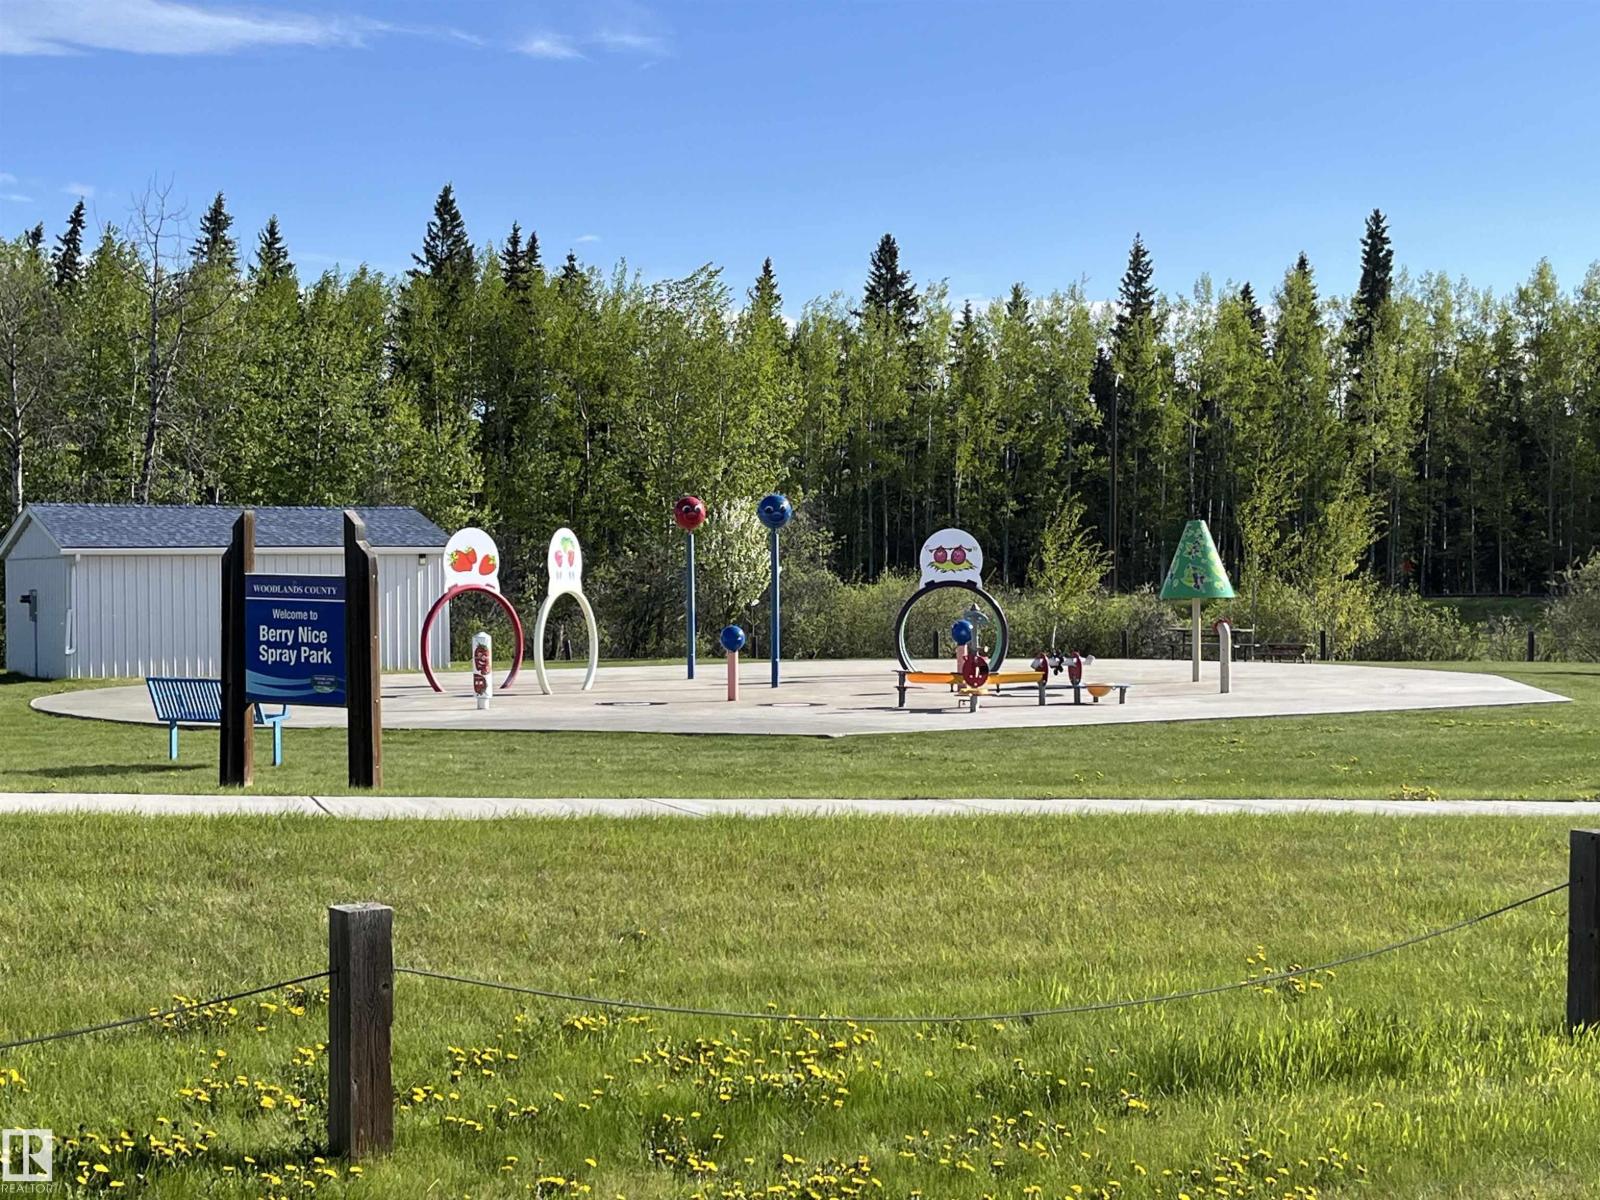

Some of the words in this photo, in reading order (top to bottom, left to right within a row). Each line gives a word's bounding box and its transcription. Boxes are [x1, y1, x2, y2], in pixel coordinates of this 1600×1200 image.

[253, 584, 303, 594] WOODLANDS
[304, 585, 337, 595] COUNTY
[272, 608, 308, 620] Welcome
[310, 610, 318, 620] to
[259, 625, 295, 645] Berry
[298, 626, 328, 643] Nice
[259, 645, 297, 666] Spray
[301, 646, 332, 664] Park
